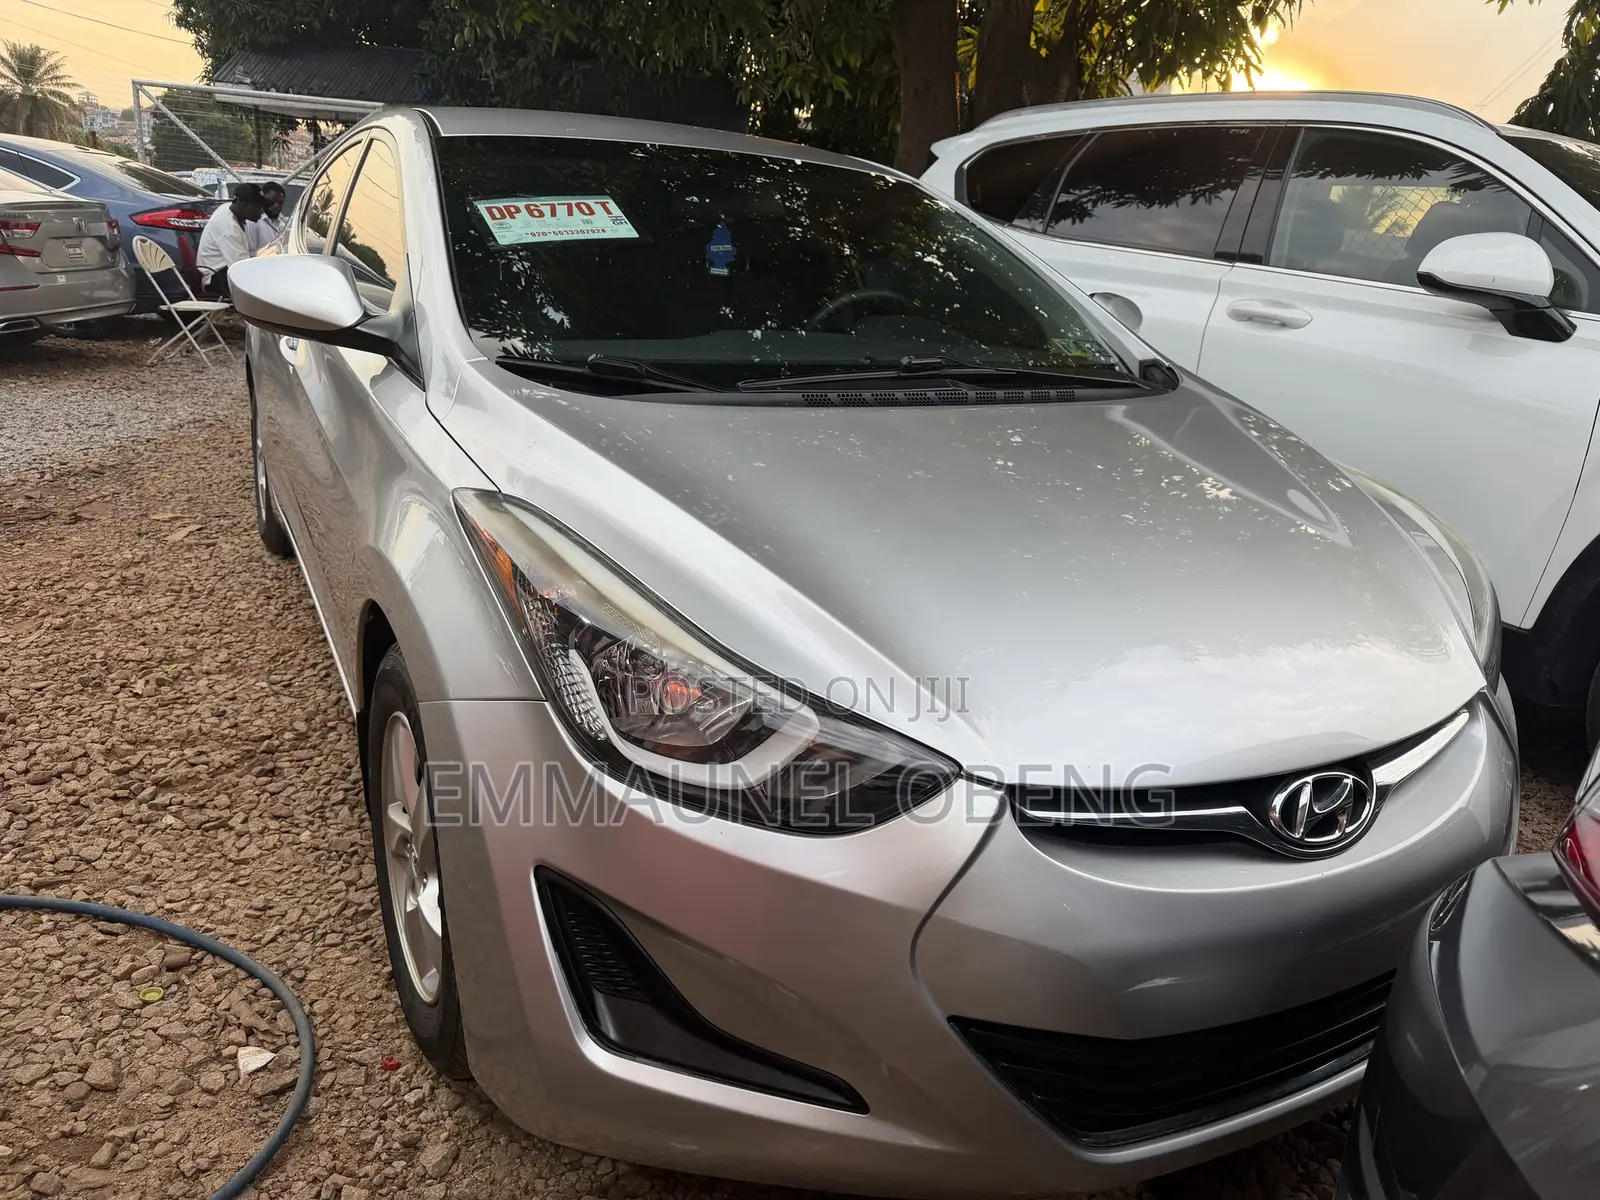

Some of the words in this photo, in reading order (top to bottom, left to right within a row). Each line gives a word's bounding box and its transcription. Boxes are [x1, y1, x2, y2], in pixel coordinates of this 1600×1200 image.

[484, 205, 522, 221] DP
[523, 202, 596, 219] 6770
[593, 201, 614, 215] T
